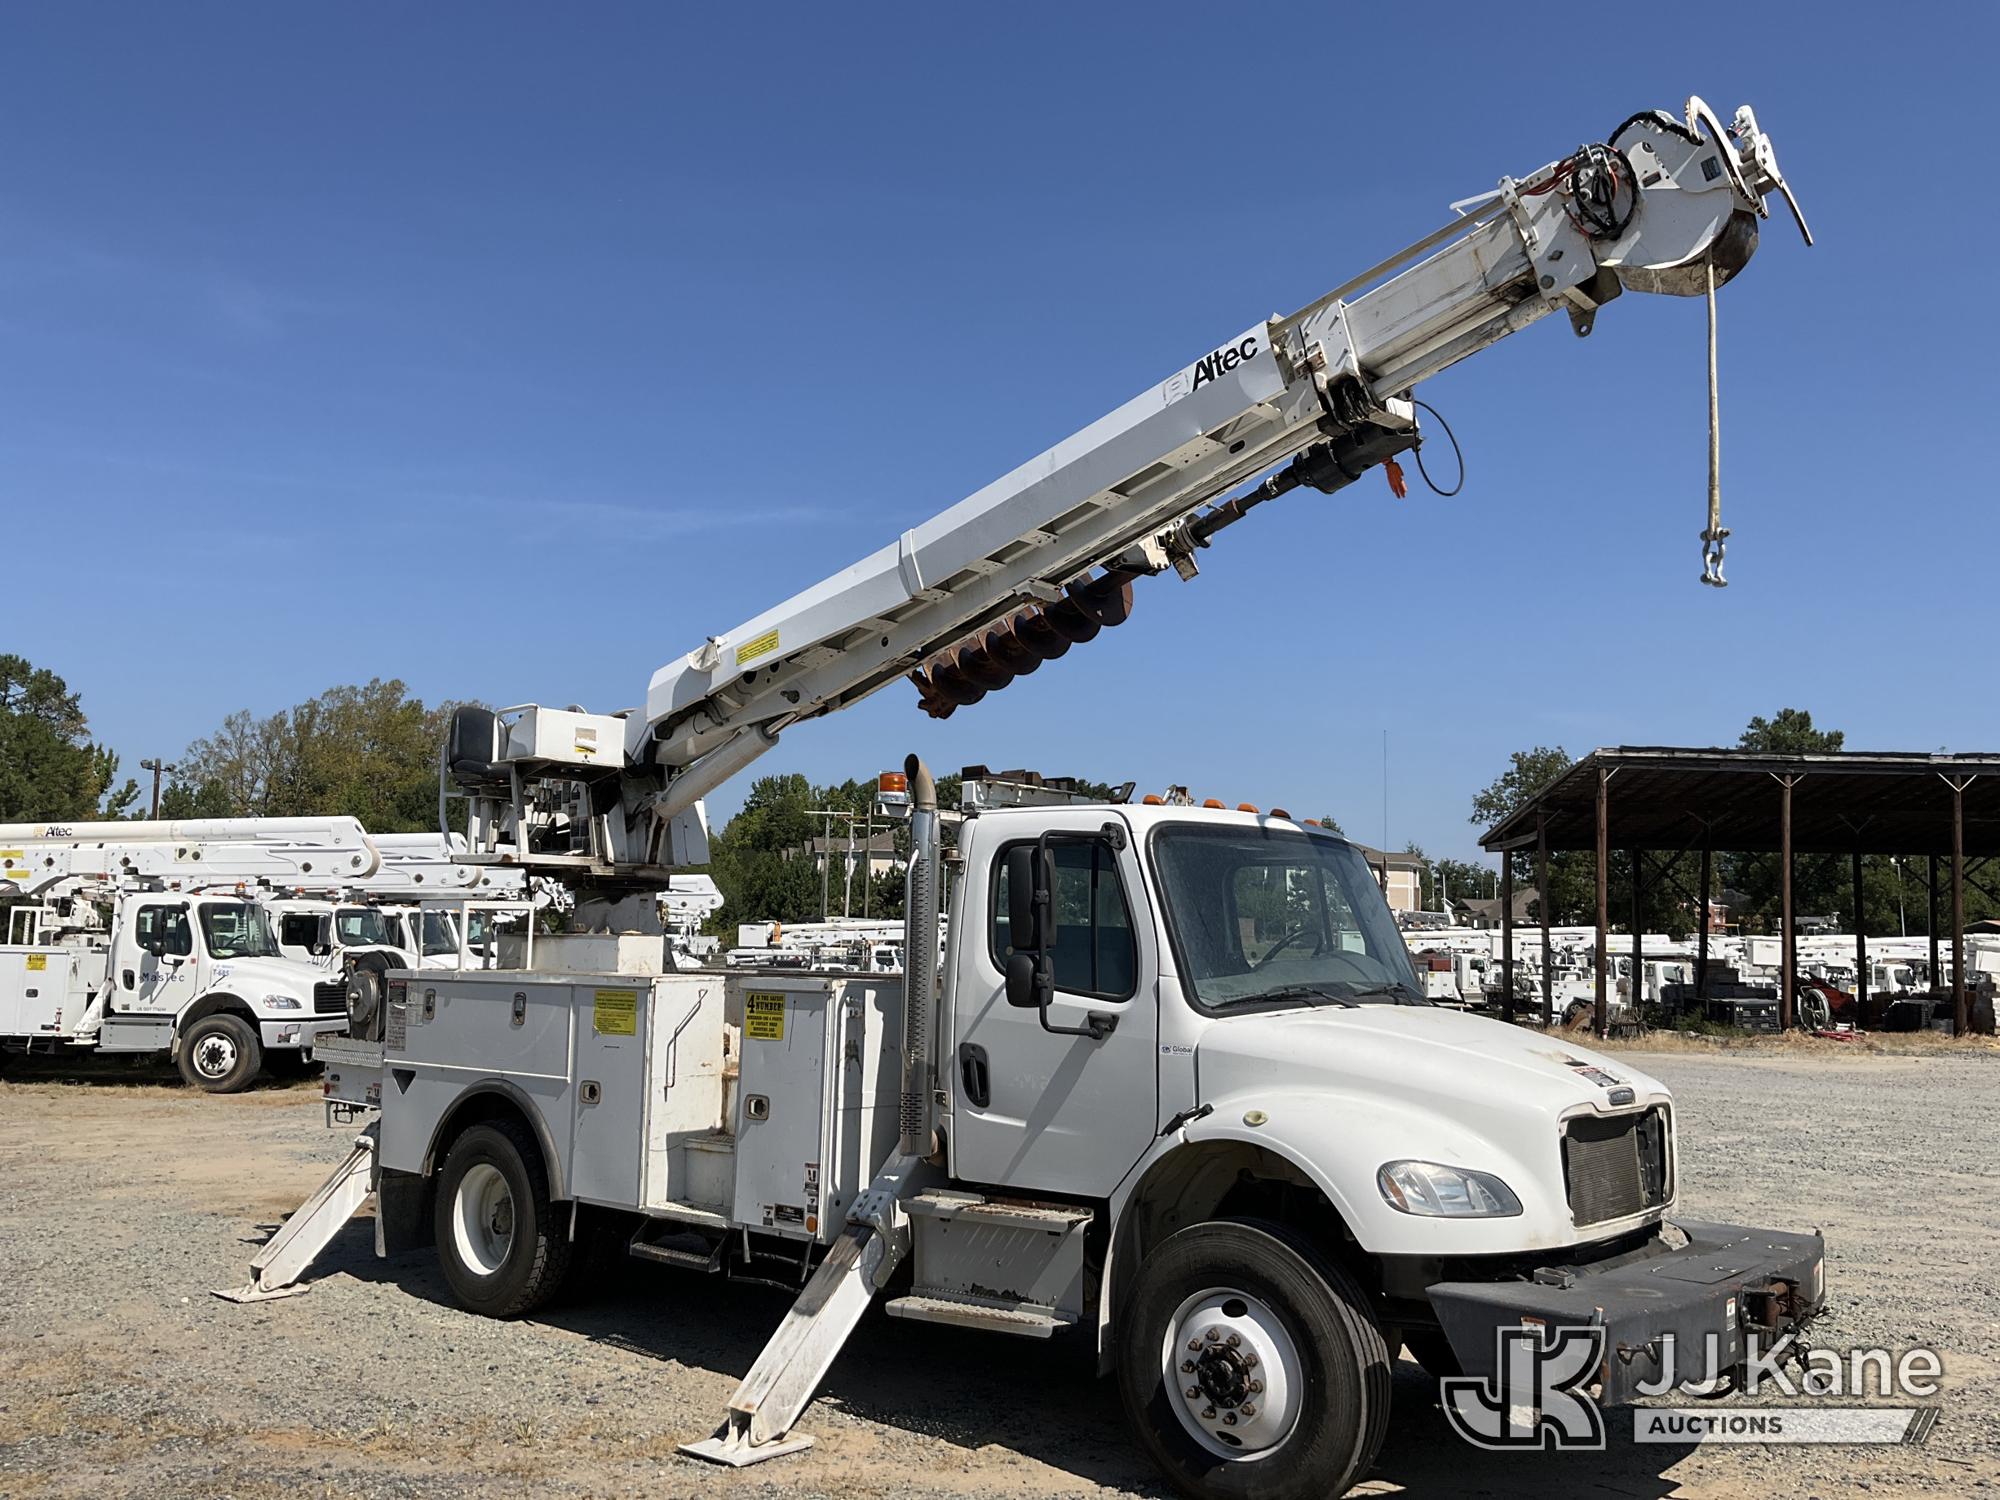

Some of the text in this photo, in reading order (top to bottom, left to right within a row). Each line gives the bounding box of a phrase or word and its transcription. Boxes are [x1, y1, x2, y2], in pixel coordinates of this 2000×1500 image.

[1192, 337, 1258, 392] Altec
[45, 827, 72, 837] Altec
[142, 972, 185, 982] MasTec
[747, 995, 755, 1013] 4
